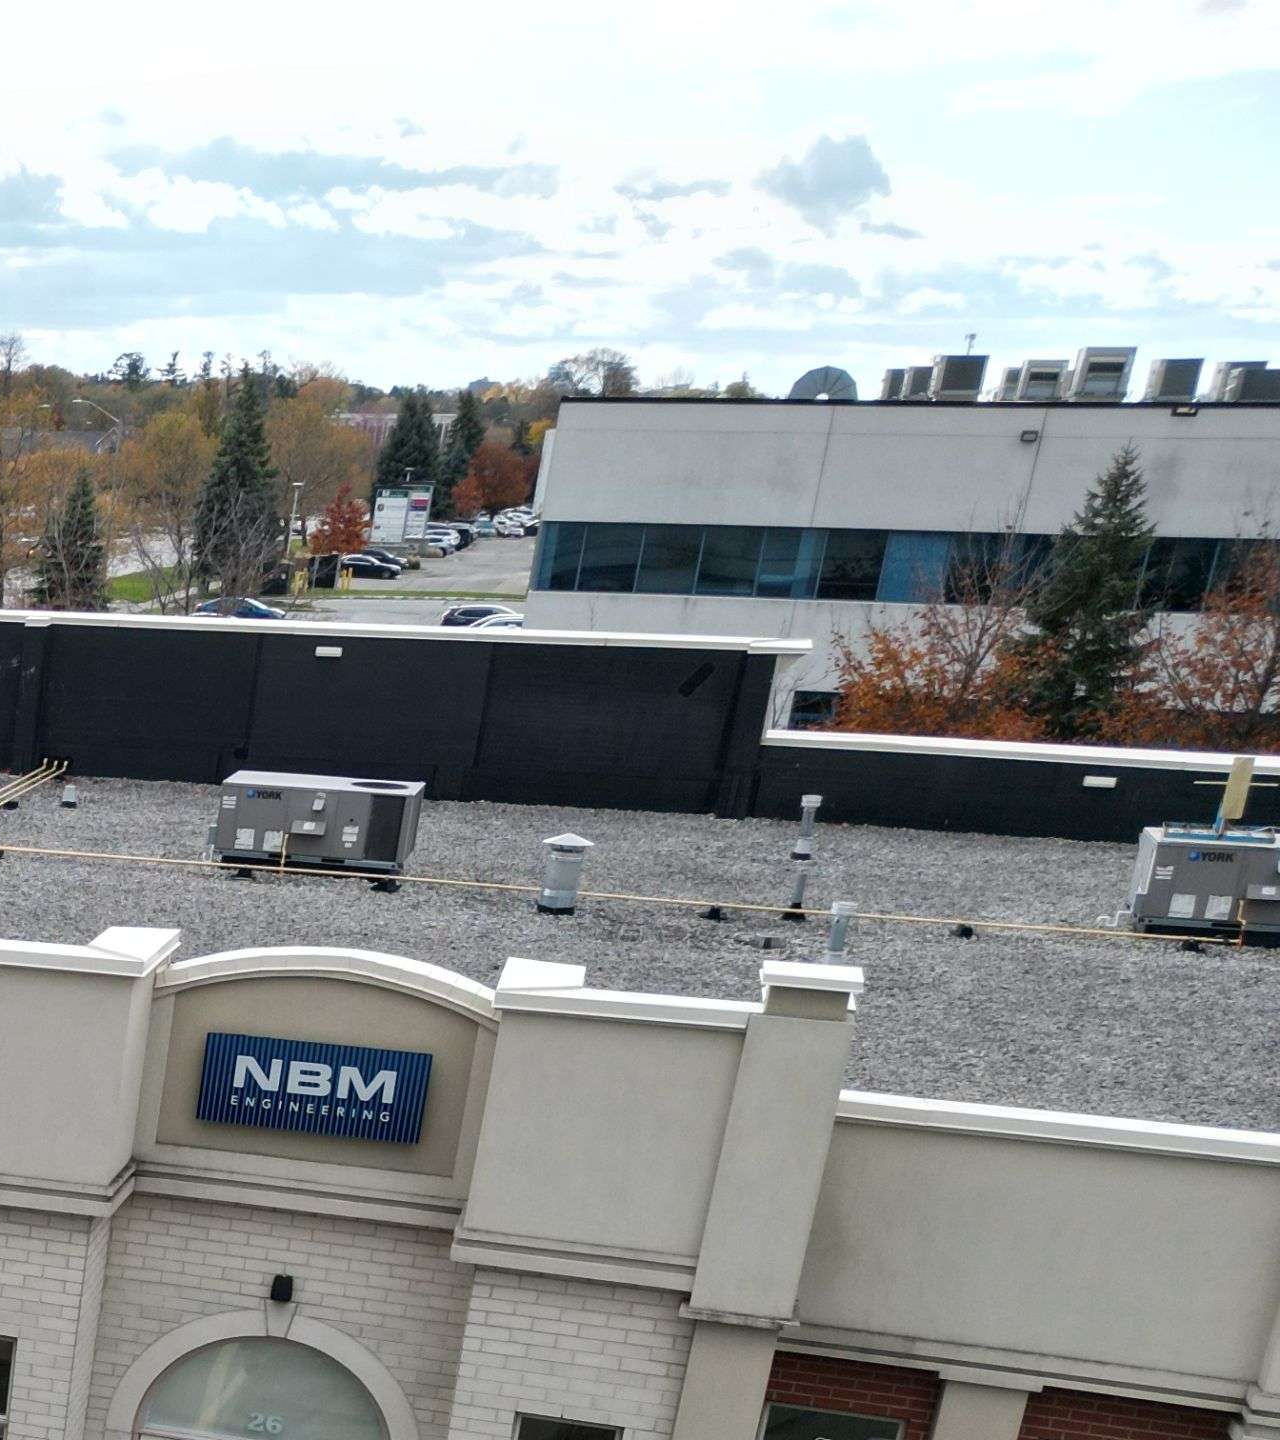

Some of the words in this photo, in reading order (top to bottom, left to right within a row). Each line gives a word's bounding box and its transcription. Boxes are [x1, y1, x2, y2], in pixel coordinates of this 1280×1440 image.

[256, 789, 282, 800] YORK
[1200, 851, 1234, 863] YORK
[232, 1054, 398, 1105] NBM
[229, 1094, 391, 1122] ENGINEERING
[247, 1412, 284, 1434] 26
